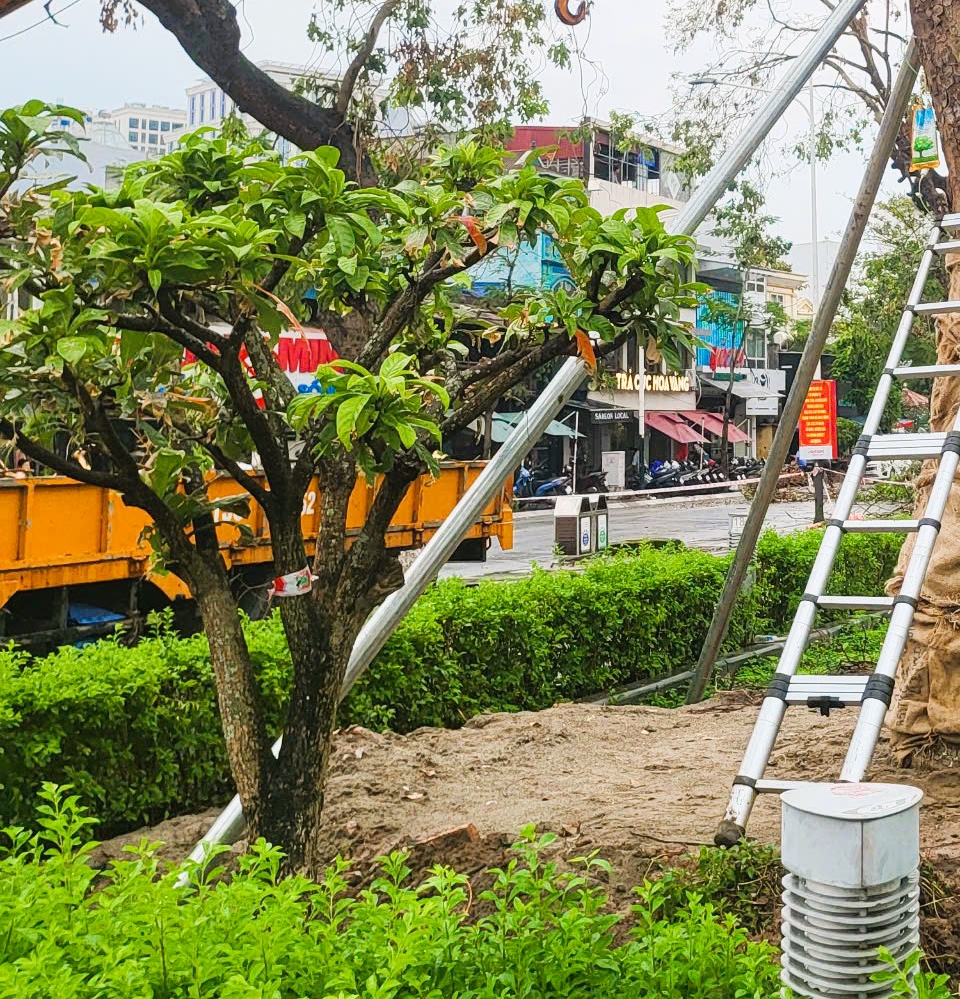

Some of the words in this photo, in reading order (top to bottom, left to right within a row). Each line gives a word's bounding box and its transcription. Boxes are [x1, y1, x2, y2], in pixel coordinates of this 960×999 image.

[634, 369, 651, 392] CC
[652, 375, 669, 392] HOA
[668, 371, 690, 392] VÀNG
[614, 412, 630, 420] LOCAL
